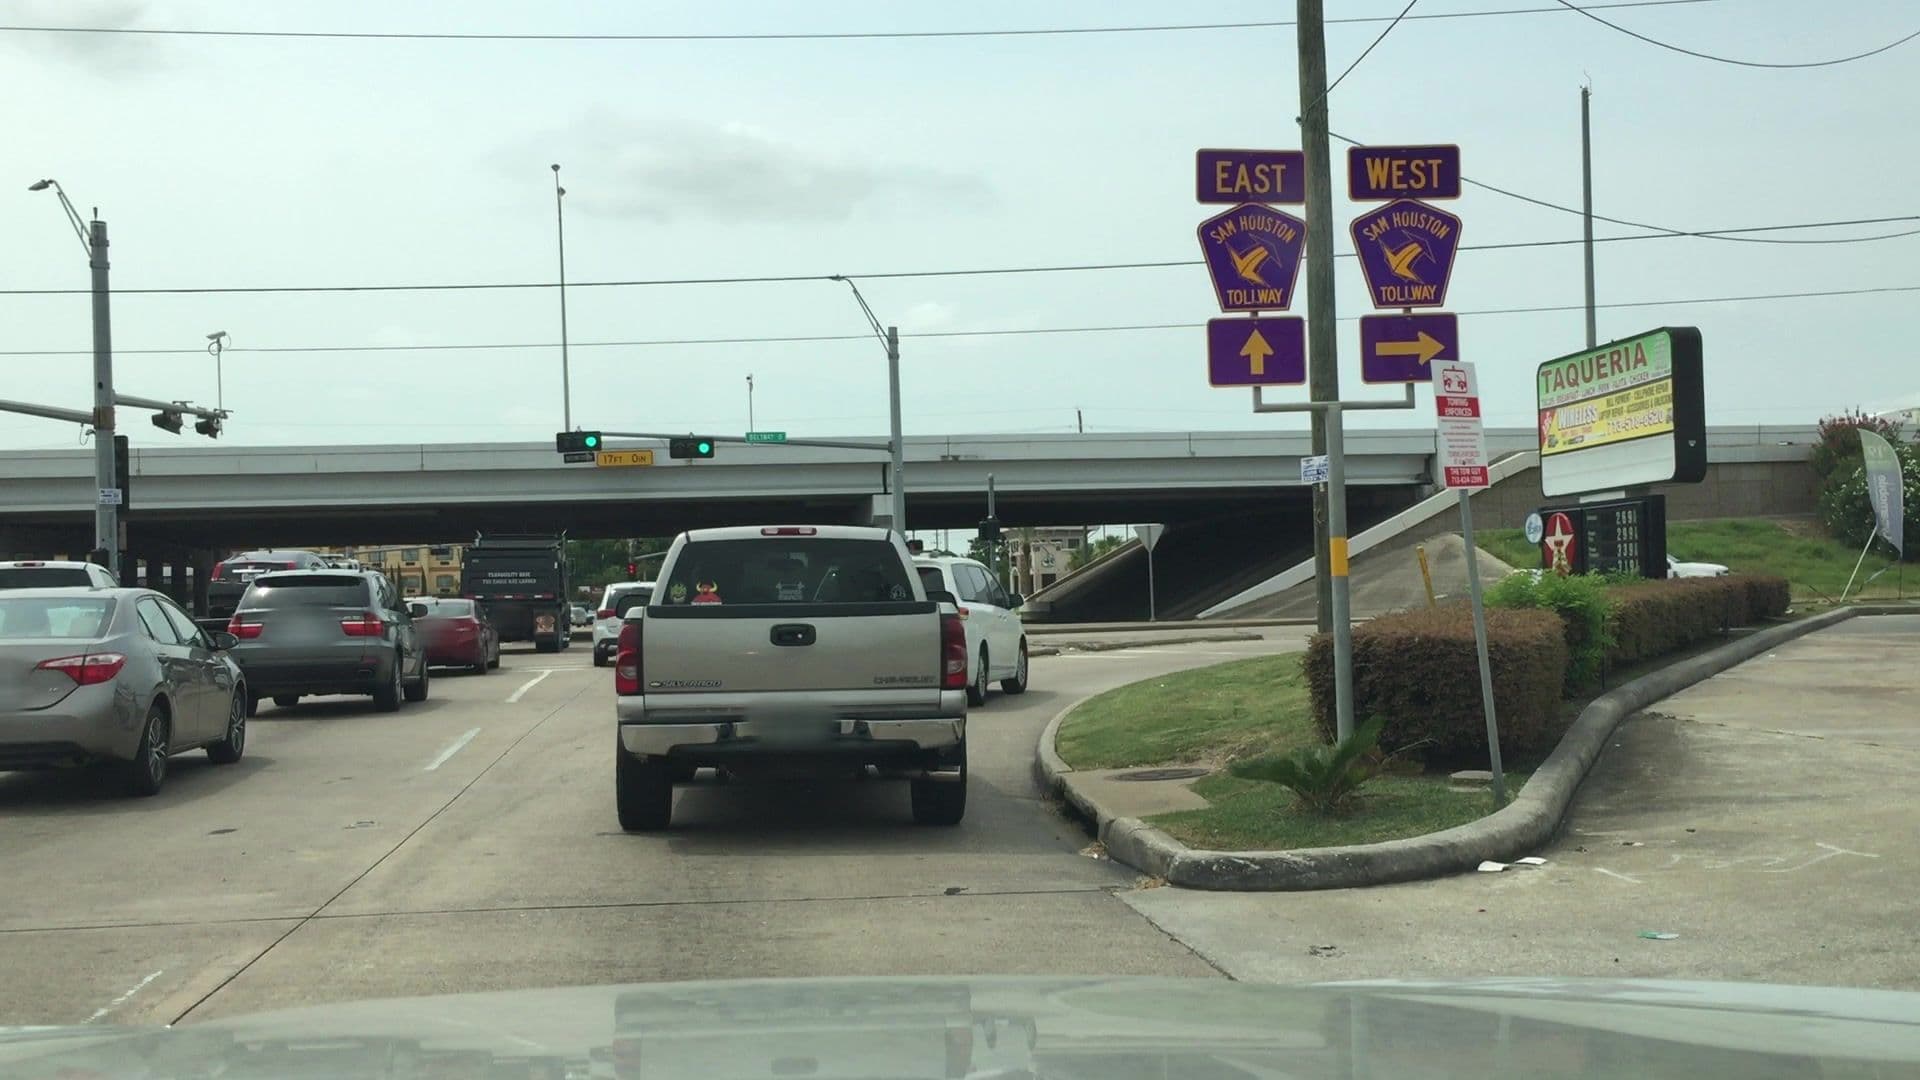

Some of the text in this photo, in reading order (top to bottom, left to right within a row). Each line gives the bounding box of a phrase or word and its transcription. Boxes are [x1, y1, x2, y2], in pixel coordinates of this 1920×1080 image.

[1215, 160, 1286, 194] EAST
[1365, 157, 1442, 190] WEST
[1210, 215, 1297, 245] SAM HOUSTON
[1363, 211, 1451, 241] SAM HOUSTON
[1227, 288, 1283, 305] TOLLWAY
[1380, 285, 1437, 302] TOLLWAY
[1541, 342, 1649, 394] TAQUERIA
